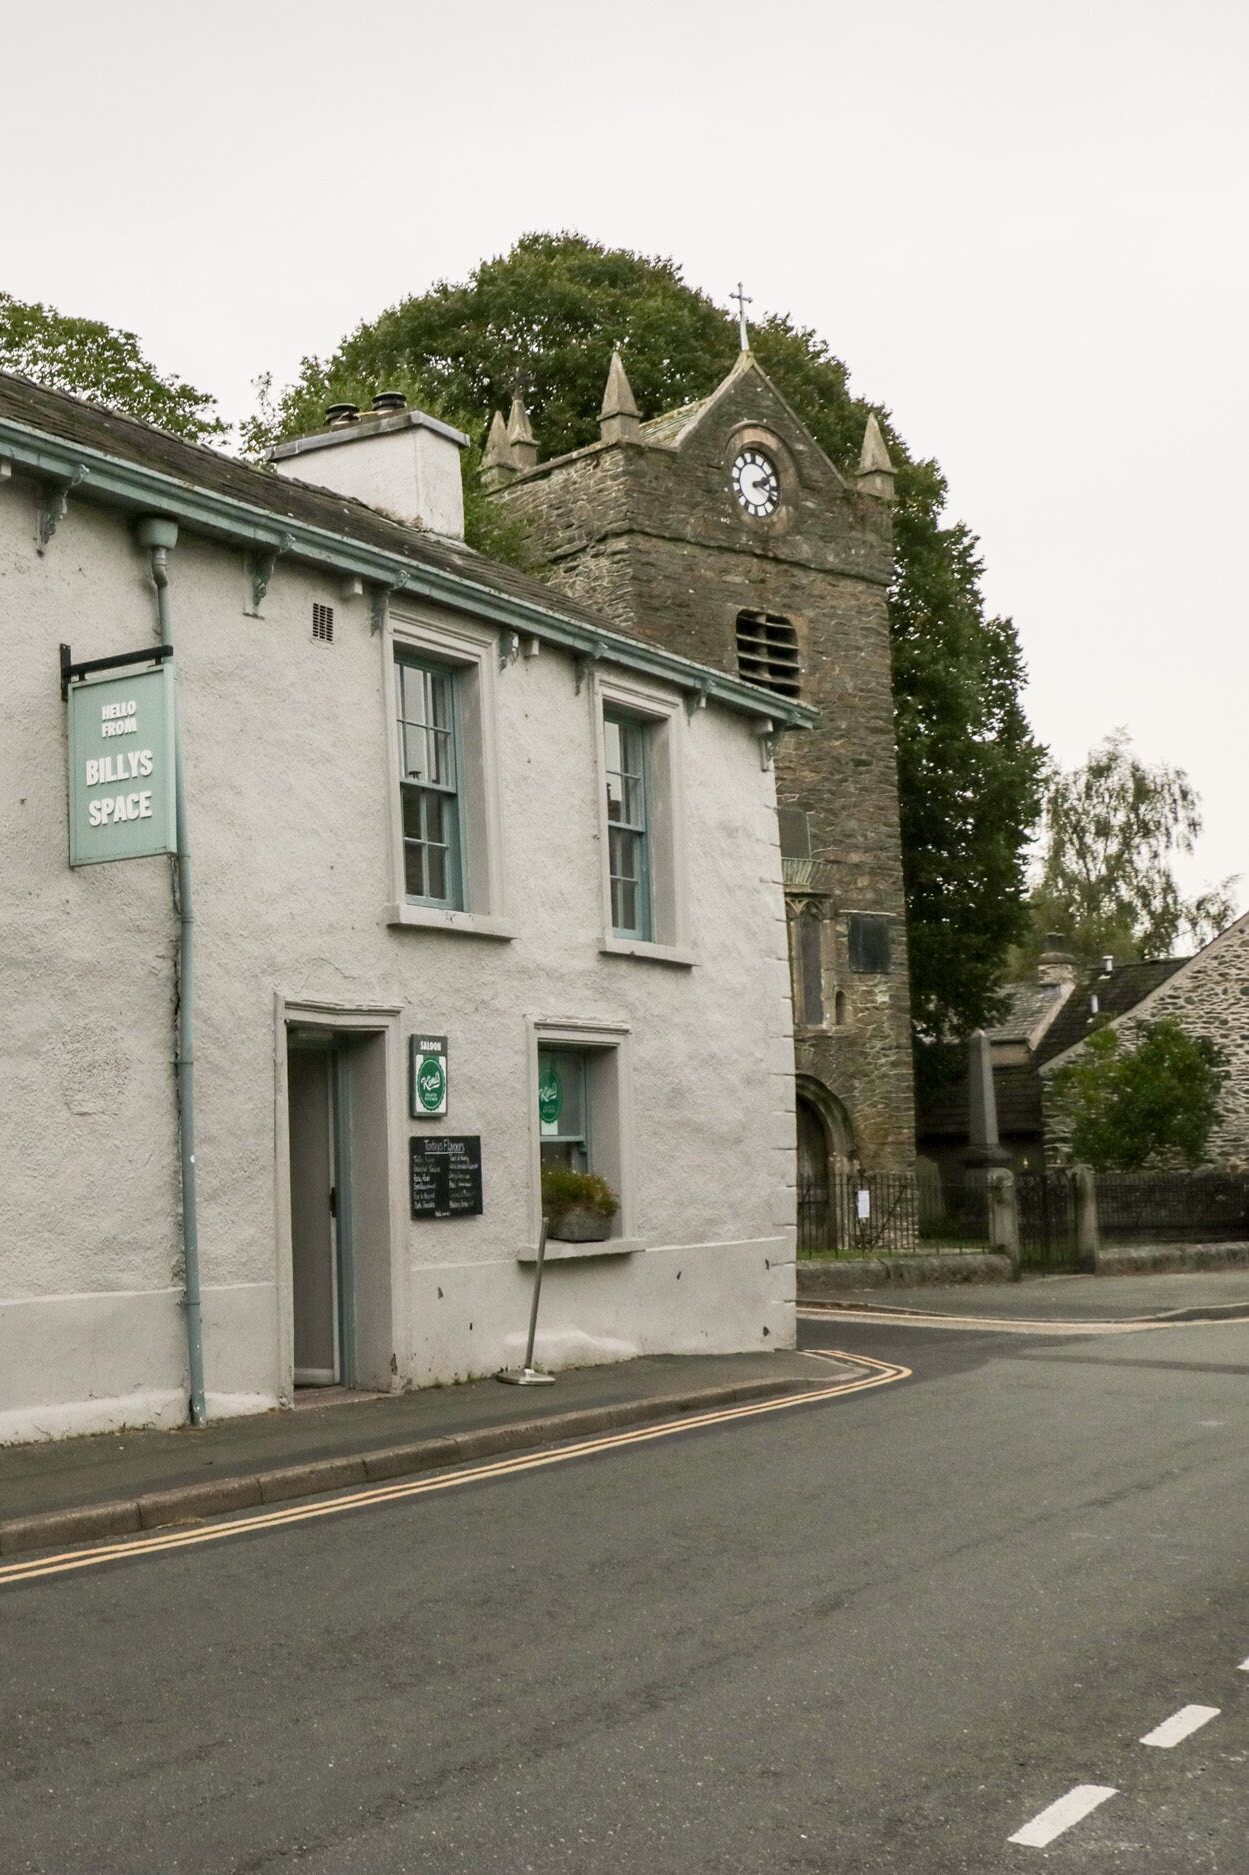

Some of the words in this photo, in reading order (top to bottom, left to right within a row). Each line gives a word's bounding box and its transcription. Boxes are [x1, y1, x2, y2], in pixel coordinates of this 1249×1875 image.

[102, 700, 137, 721] HELLO
[101, 717, 138, 738] FROM
[85, 748, 153, 786] BILLYS
[88, 790, 153, 827] SPACE
[420, 1040, 442, 1051] SALOON
